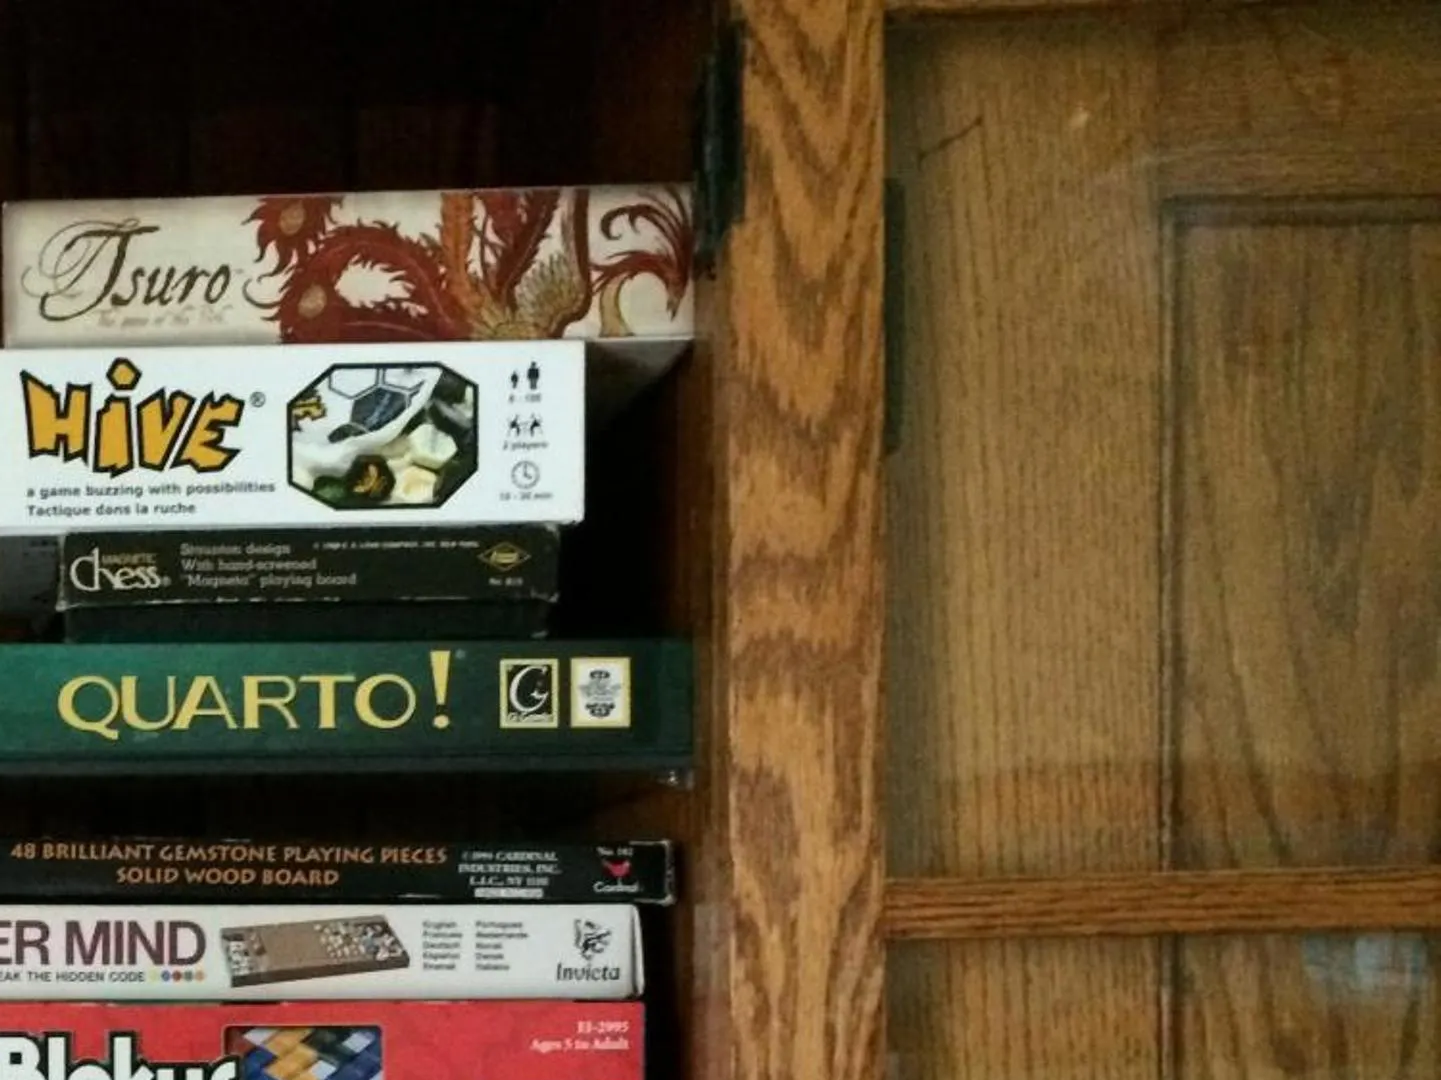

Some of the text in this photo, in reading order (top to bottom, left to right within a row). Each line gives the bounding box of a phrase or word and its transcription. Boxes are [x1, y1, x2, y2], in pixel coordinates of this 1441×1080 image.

[21, 218, 234, 322] Tsuro
[39, 484, 81, 501] game
[85, 482, 145, 500] buzzing
[148, 480, 181, 496] with
[185, 478, 276, 498] possibilities
[27, 501, 196, 519] Tactique dans la ruche
[314, 571, 357, 586] board
[58, 650, 452, 741] QUARTO!
[10, 842, 449, 865] 48 BRILLIANT GEMSTONE PLAYING PIECES
[115, 865, 341, 886] SOLID WOOD BOARD
[64, 919, 207, 967] MIND
[25, 970, 53, 983] THE
[55, 970, 106, 983] HIDDEN
[108, 969, 146, 983] CODE
[556, 962, 621, 982] Invicta
